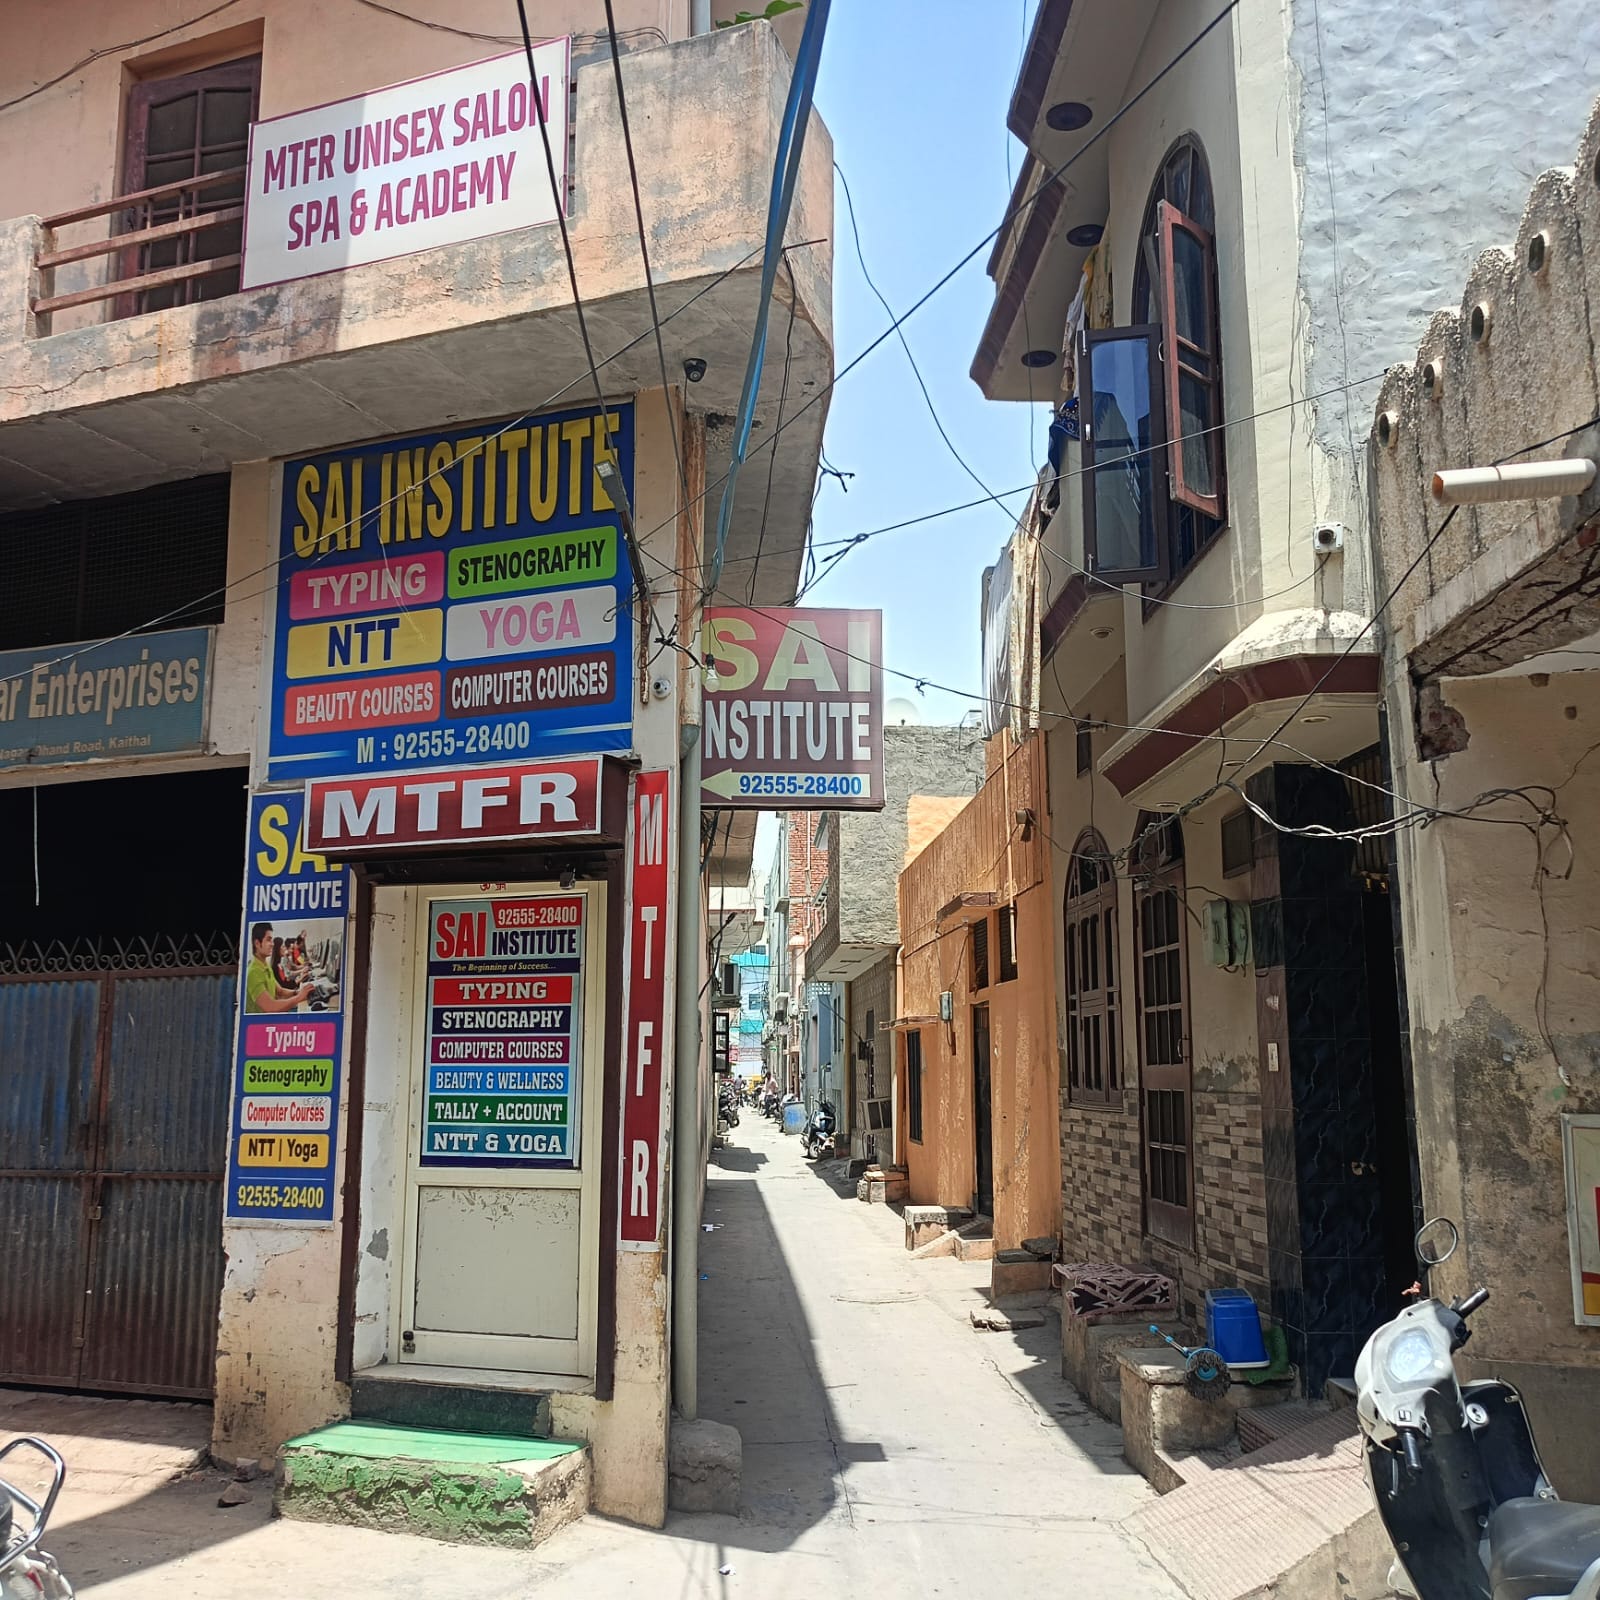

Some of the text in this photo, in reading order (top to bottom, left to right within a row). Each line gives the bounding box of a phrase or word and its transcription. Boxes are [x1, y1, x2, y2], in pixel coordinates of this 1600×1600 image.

[263, 75, 550, 194] MTFR UNISEX SALON
[288, 151, 517, 251] SPA & ACADEMY
[293, 412, 620, 558] SAI INSTITUTE
[457, 539, 606, 586] STENOGRAPHY
[307, 563, 427, 609] TYPING
[327, 617, 400, 668] NTT
[479, 599, 581, 649] YOGA
[702, 617, 871, 693] SAI
[28, 648, 199, 726] Enterprises
[295, 682, 433, 725] BEAUTY COURSES
[451, 661, 608, 710] COMPUTER COURSES
[108, 734, 151, 749] Kaithal
[357, 721, 530, 764] M : 92555-28400
[705, 699, 871, 761] NSTITUTE
[739, 775, 862, 795] 92555-28400
[322, 772, 578, 838] MTFR
[256, 803, 343, 878] SA
[253, 880, 343, 913] INSTITUTE
[497, 906, 578, 925] 92555-28400
[435, 912, 577, 959] SAI INSTITUTE
[452, 963, 466, 972] The
[468, 963, 507, 973] Beginning
[459, 982, 548, 1000] TYPING
[442, 1010, 564, 1029] STENOGRAPHY
[265, 1025, 316, 1053] Typing
[439, 1041, 564, 1059] COMPUTER COURSES
[248, 1064, 328, 1087] Stenography
[436, 1072, 564, 1090] BEAUTY & WELLNESS
[247, 1102, 289, 1126] Computer
[290, 1101, 325, 1122] Courses
[434, 1102, 563, 1122] TALLY + ACCOUNT
[248, 1138, 275, 1157] NTT
[287, 1138, 318, 1162] Yoga
[434, 1133, 563, 1153] NTT & YOGA
[237, 1185, 324, 1208] 92555-28400
